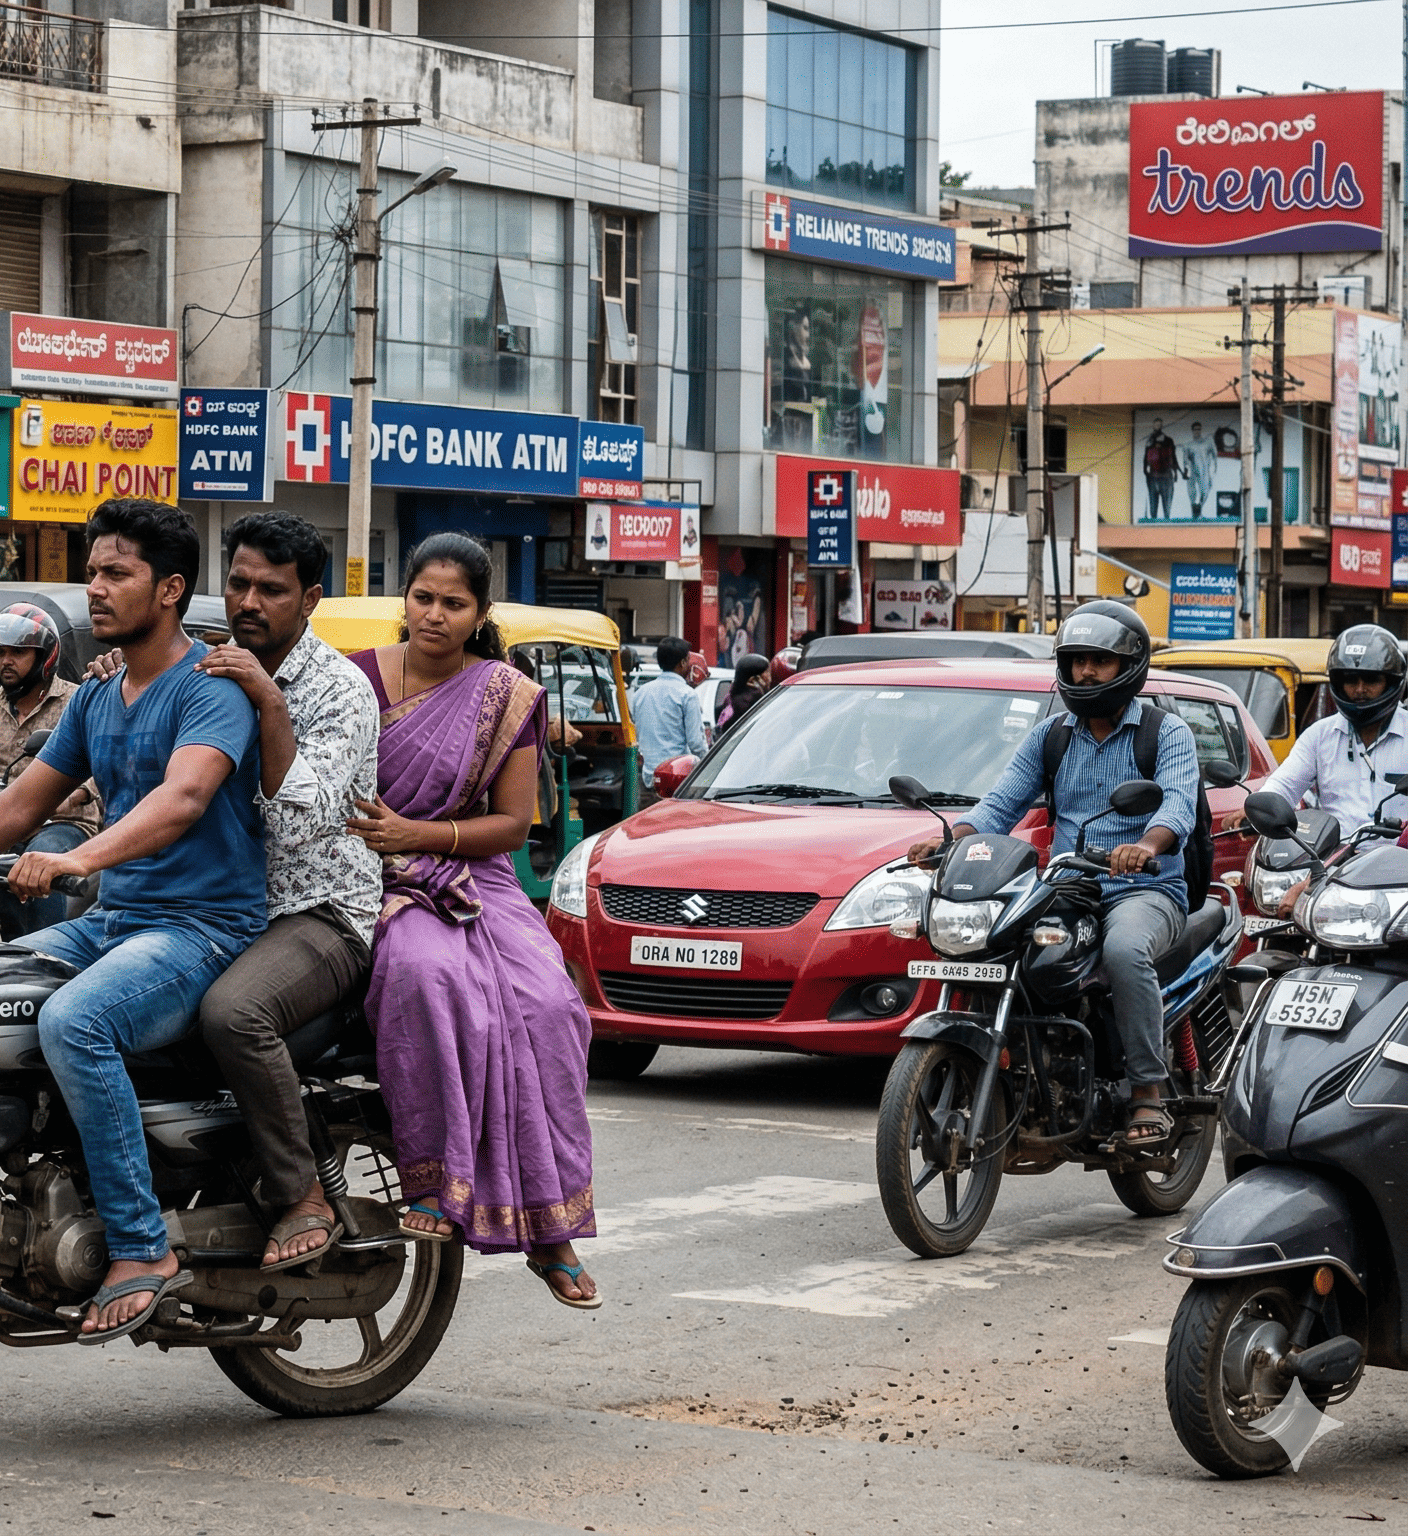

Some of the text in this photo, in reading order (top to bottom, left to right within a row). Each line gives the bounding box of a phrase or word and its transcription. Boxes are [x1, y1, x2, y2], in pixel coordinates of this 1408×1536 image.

[1143, 140, 1364, 214] trends
[796, 213, 862, 247] RELIANCE
[865, 226, 909, 256] TRENDS
[186, 424, 259, 436] HDFC BANK
[426, 427, 502, 469] BANK
[512, 433, 568, 473] ATM
[21, 458, 177, 498] CHAI POINT
[190, 450, 252, 472] ATM
[642, 945, 669, 961] ORA
